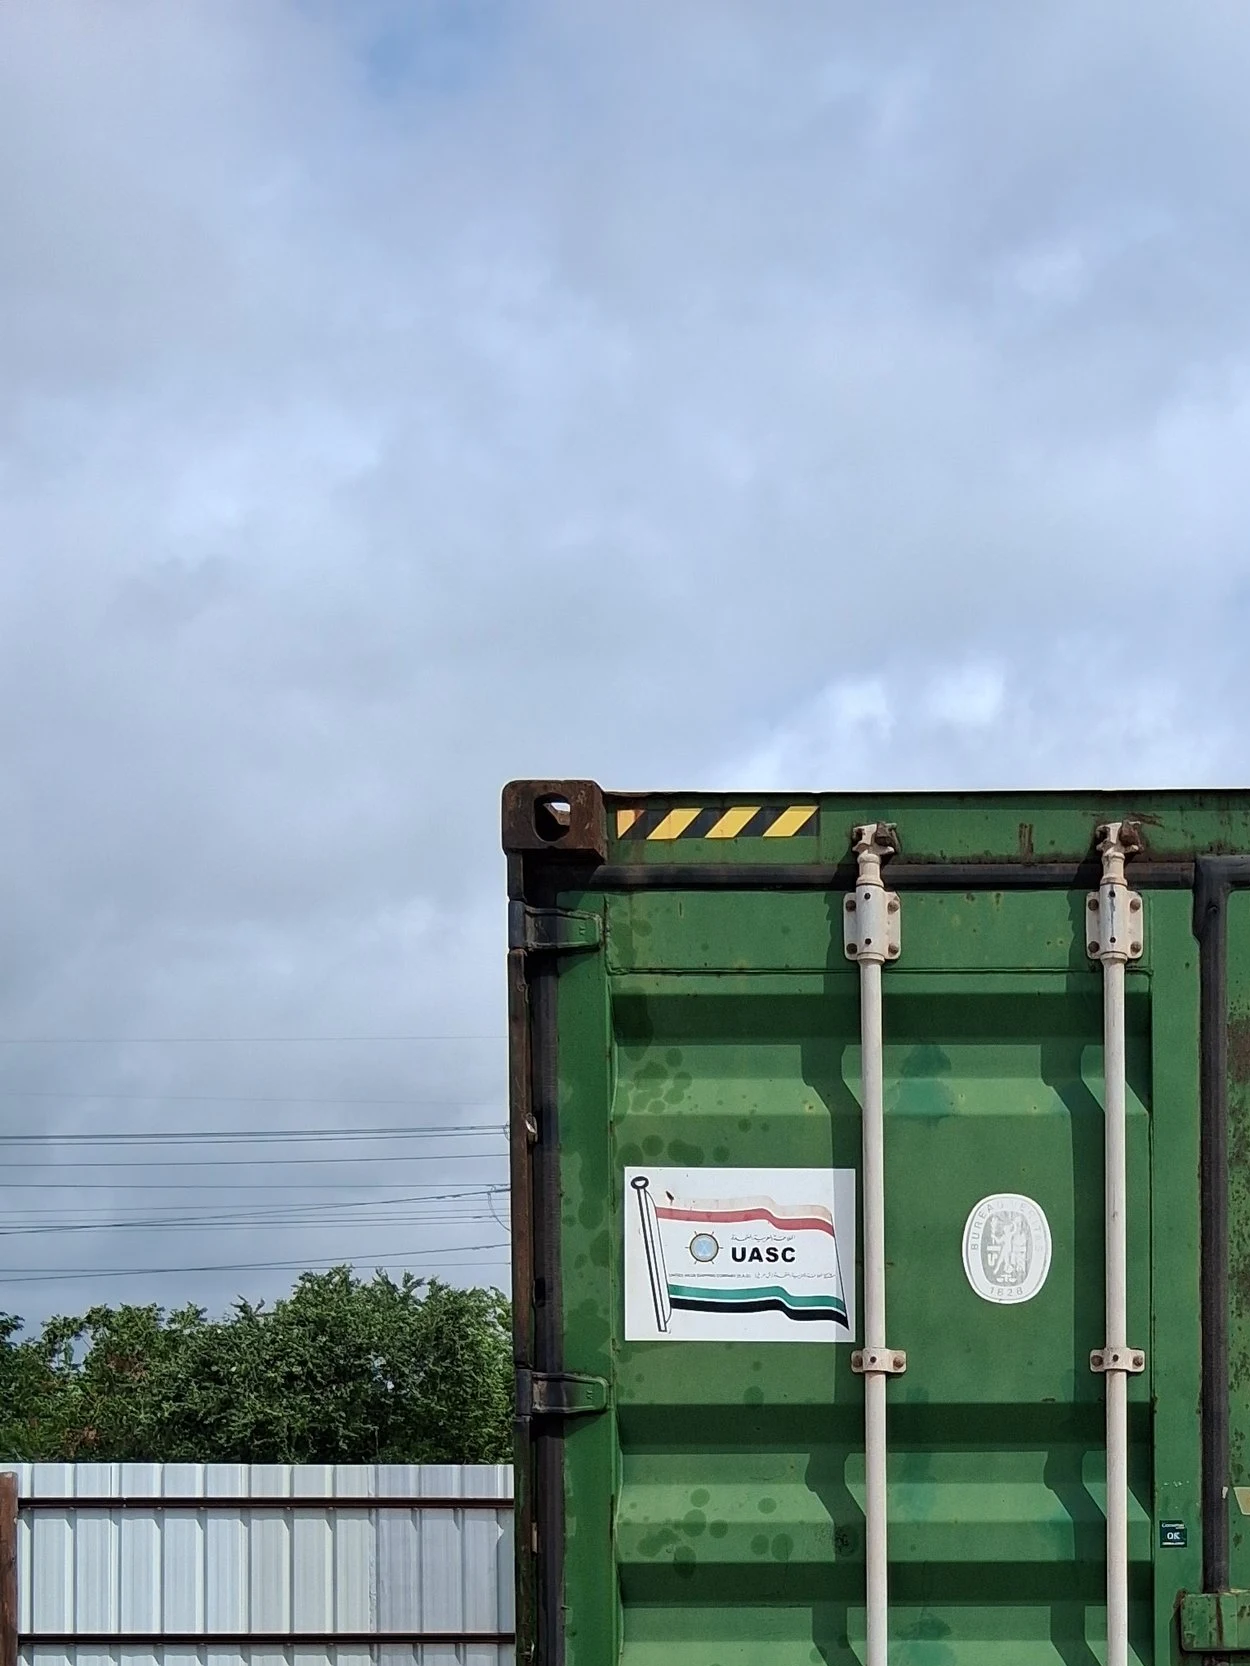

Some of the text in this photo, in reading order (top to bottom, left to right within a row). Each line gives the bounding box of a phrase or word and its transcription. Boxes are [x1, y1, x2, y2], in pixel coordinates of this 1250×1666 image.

[731, 1246, 796, 1263] UASC
[990, 1286, 1024, 1298] 1828
[1167, 1532, 1180, 1540] OK
